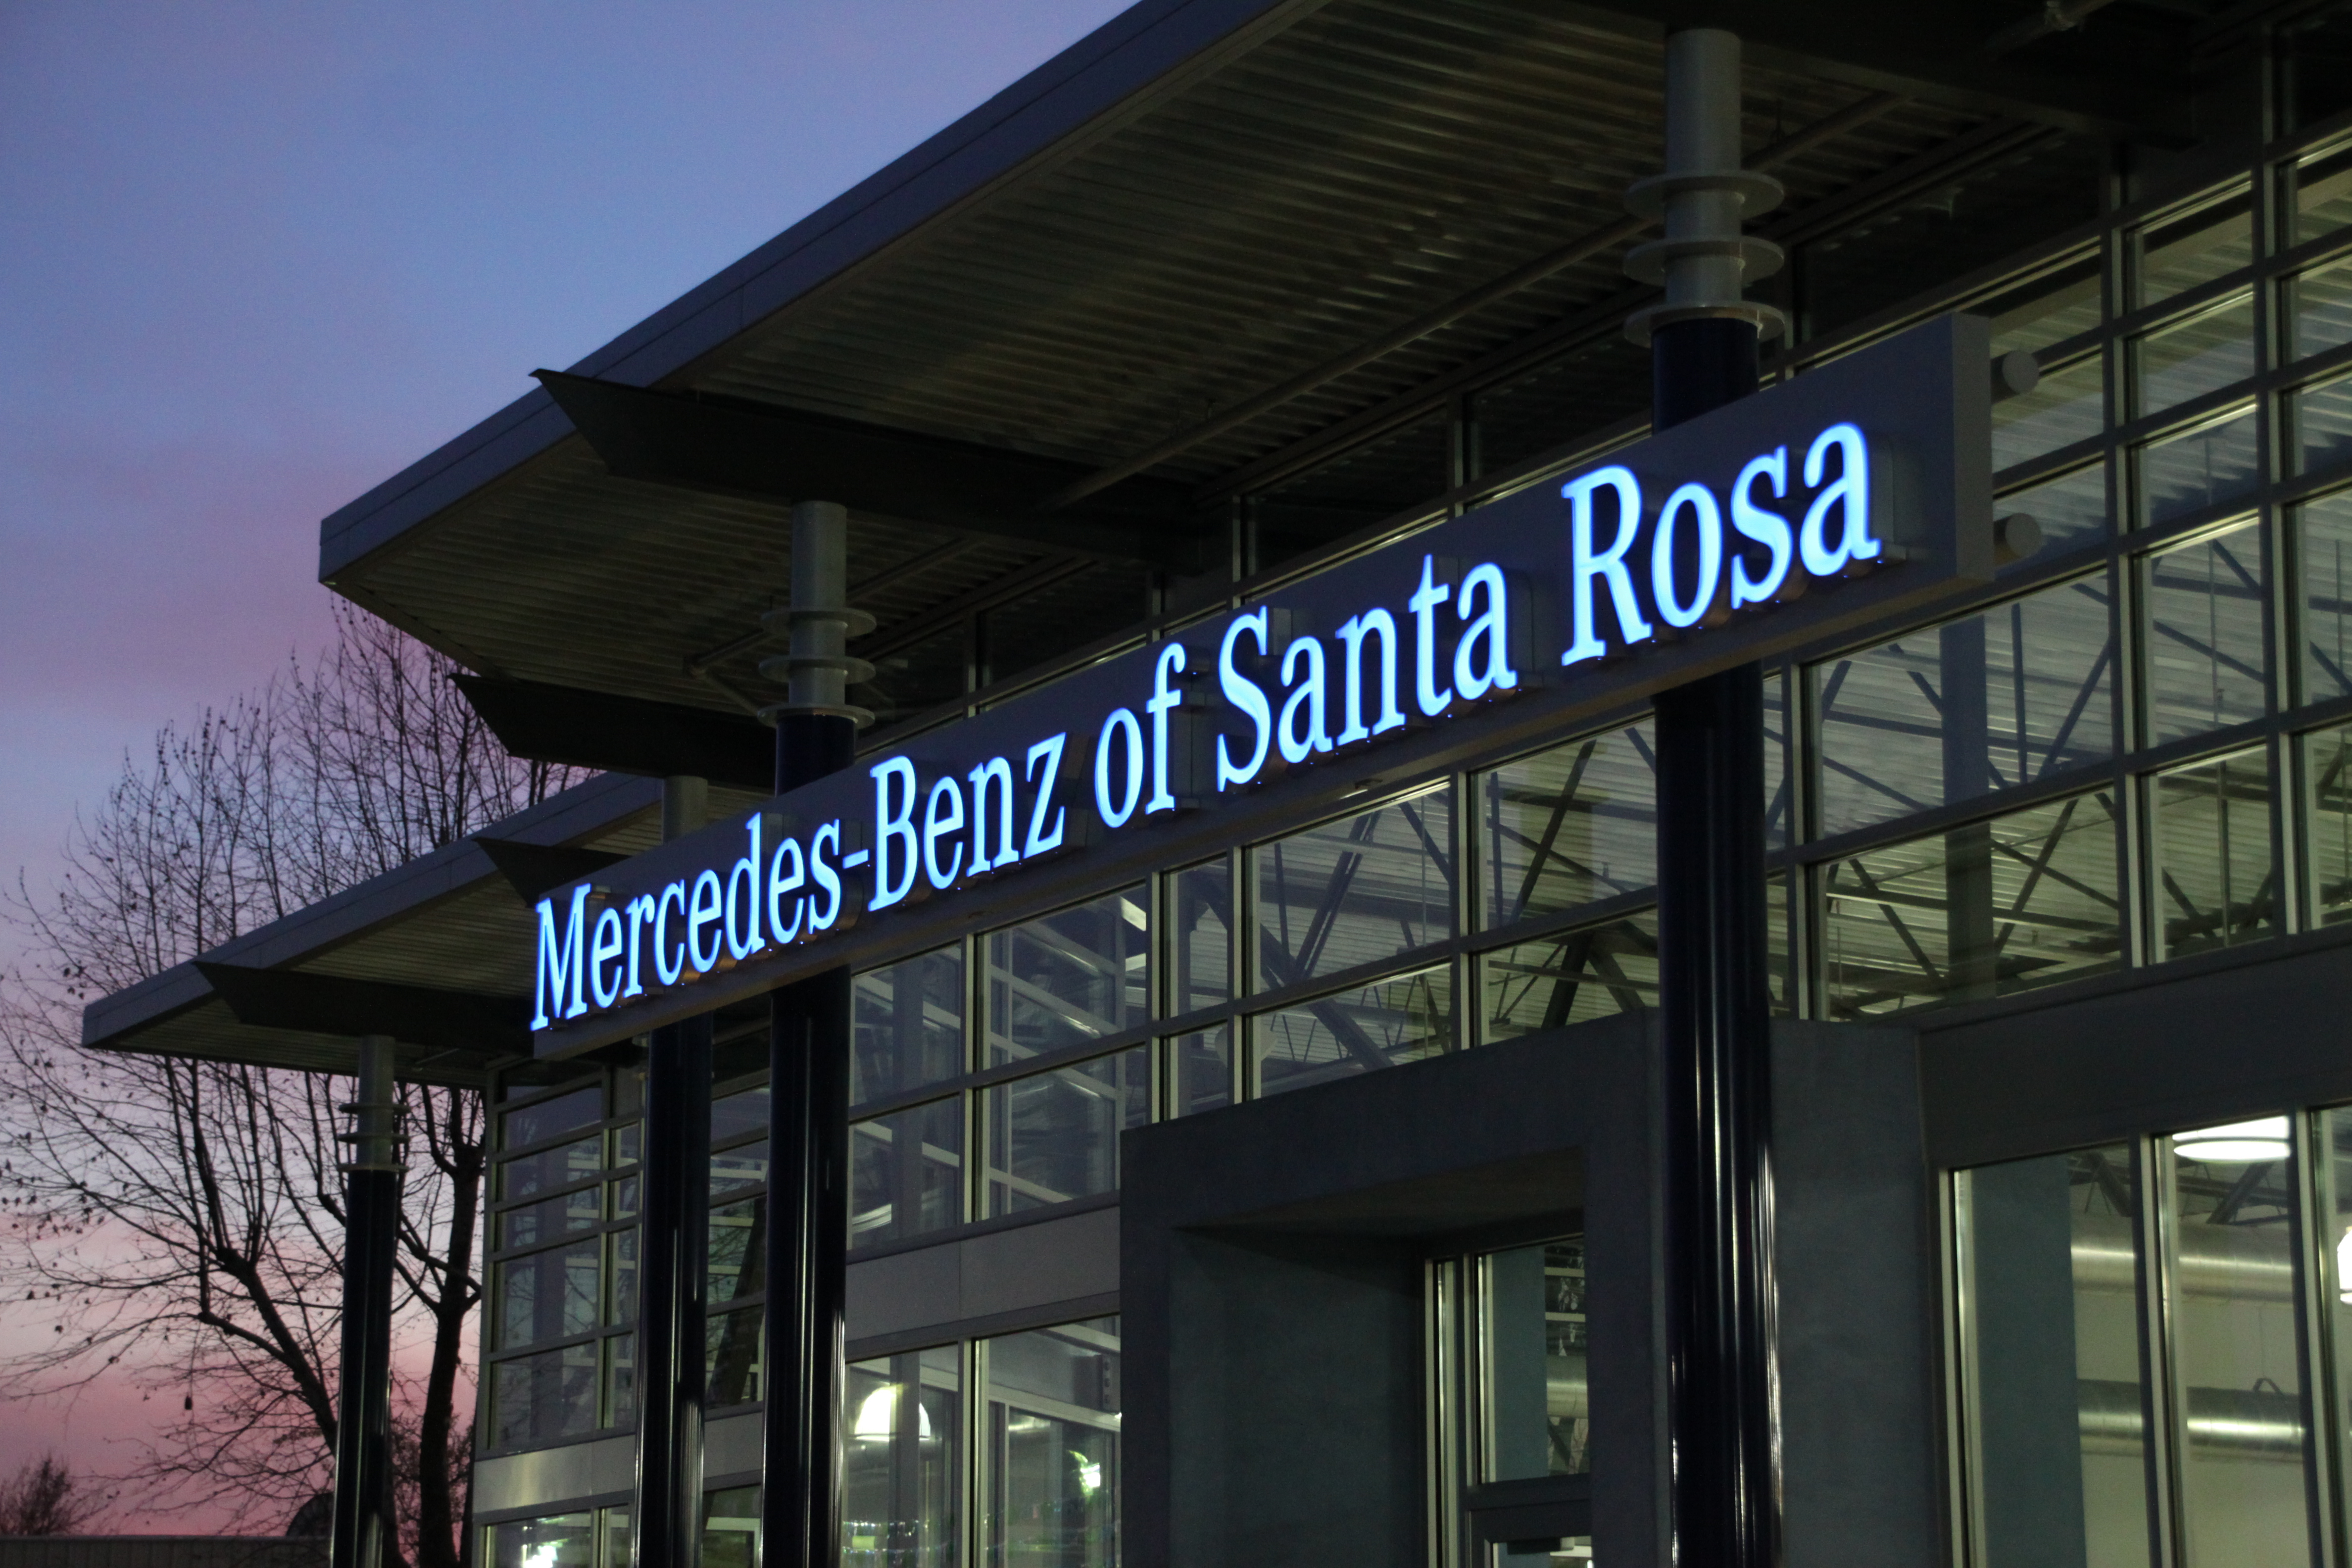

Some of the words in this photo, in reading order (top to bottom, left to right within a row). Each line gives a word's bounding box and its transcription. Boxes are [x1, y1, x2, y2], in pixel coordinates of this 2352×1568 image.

[531, 732, 1066, 1030] Mercedes-Benz
[1094, 642, 1186, 828] of
[1217, 554, 1518, 792] Santa
[1562, 422, 1881, 666] Rosa
